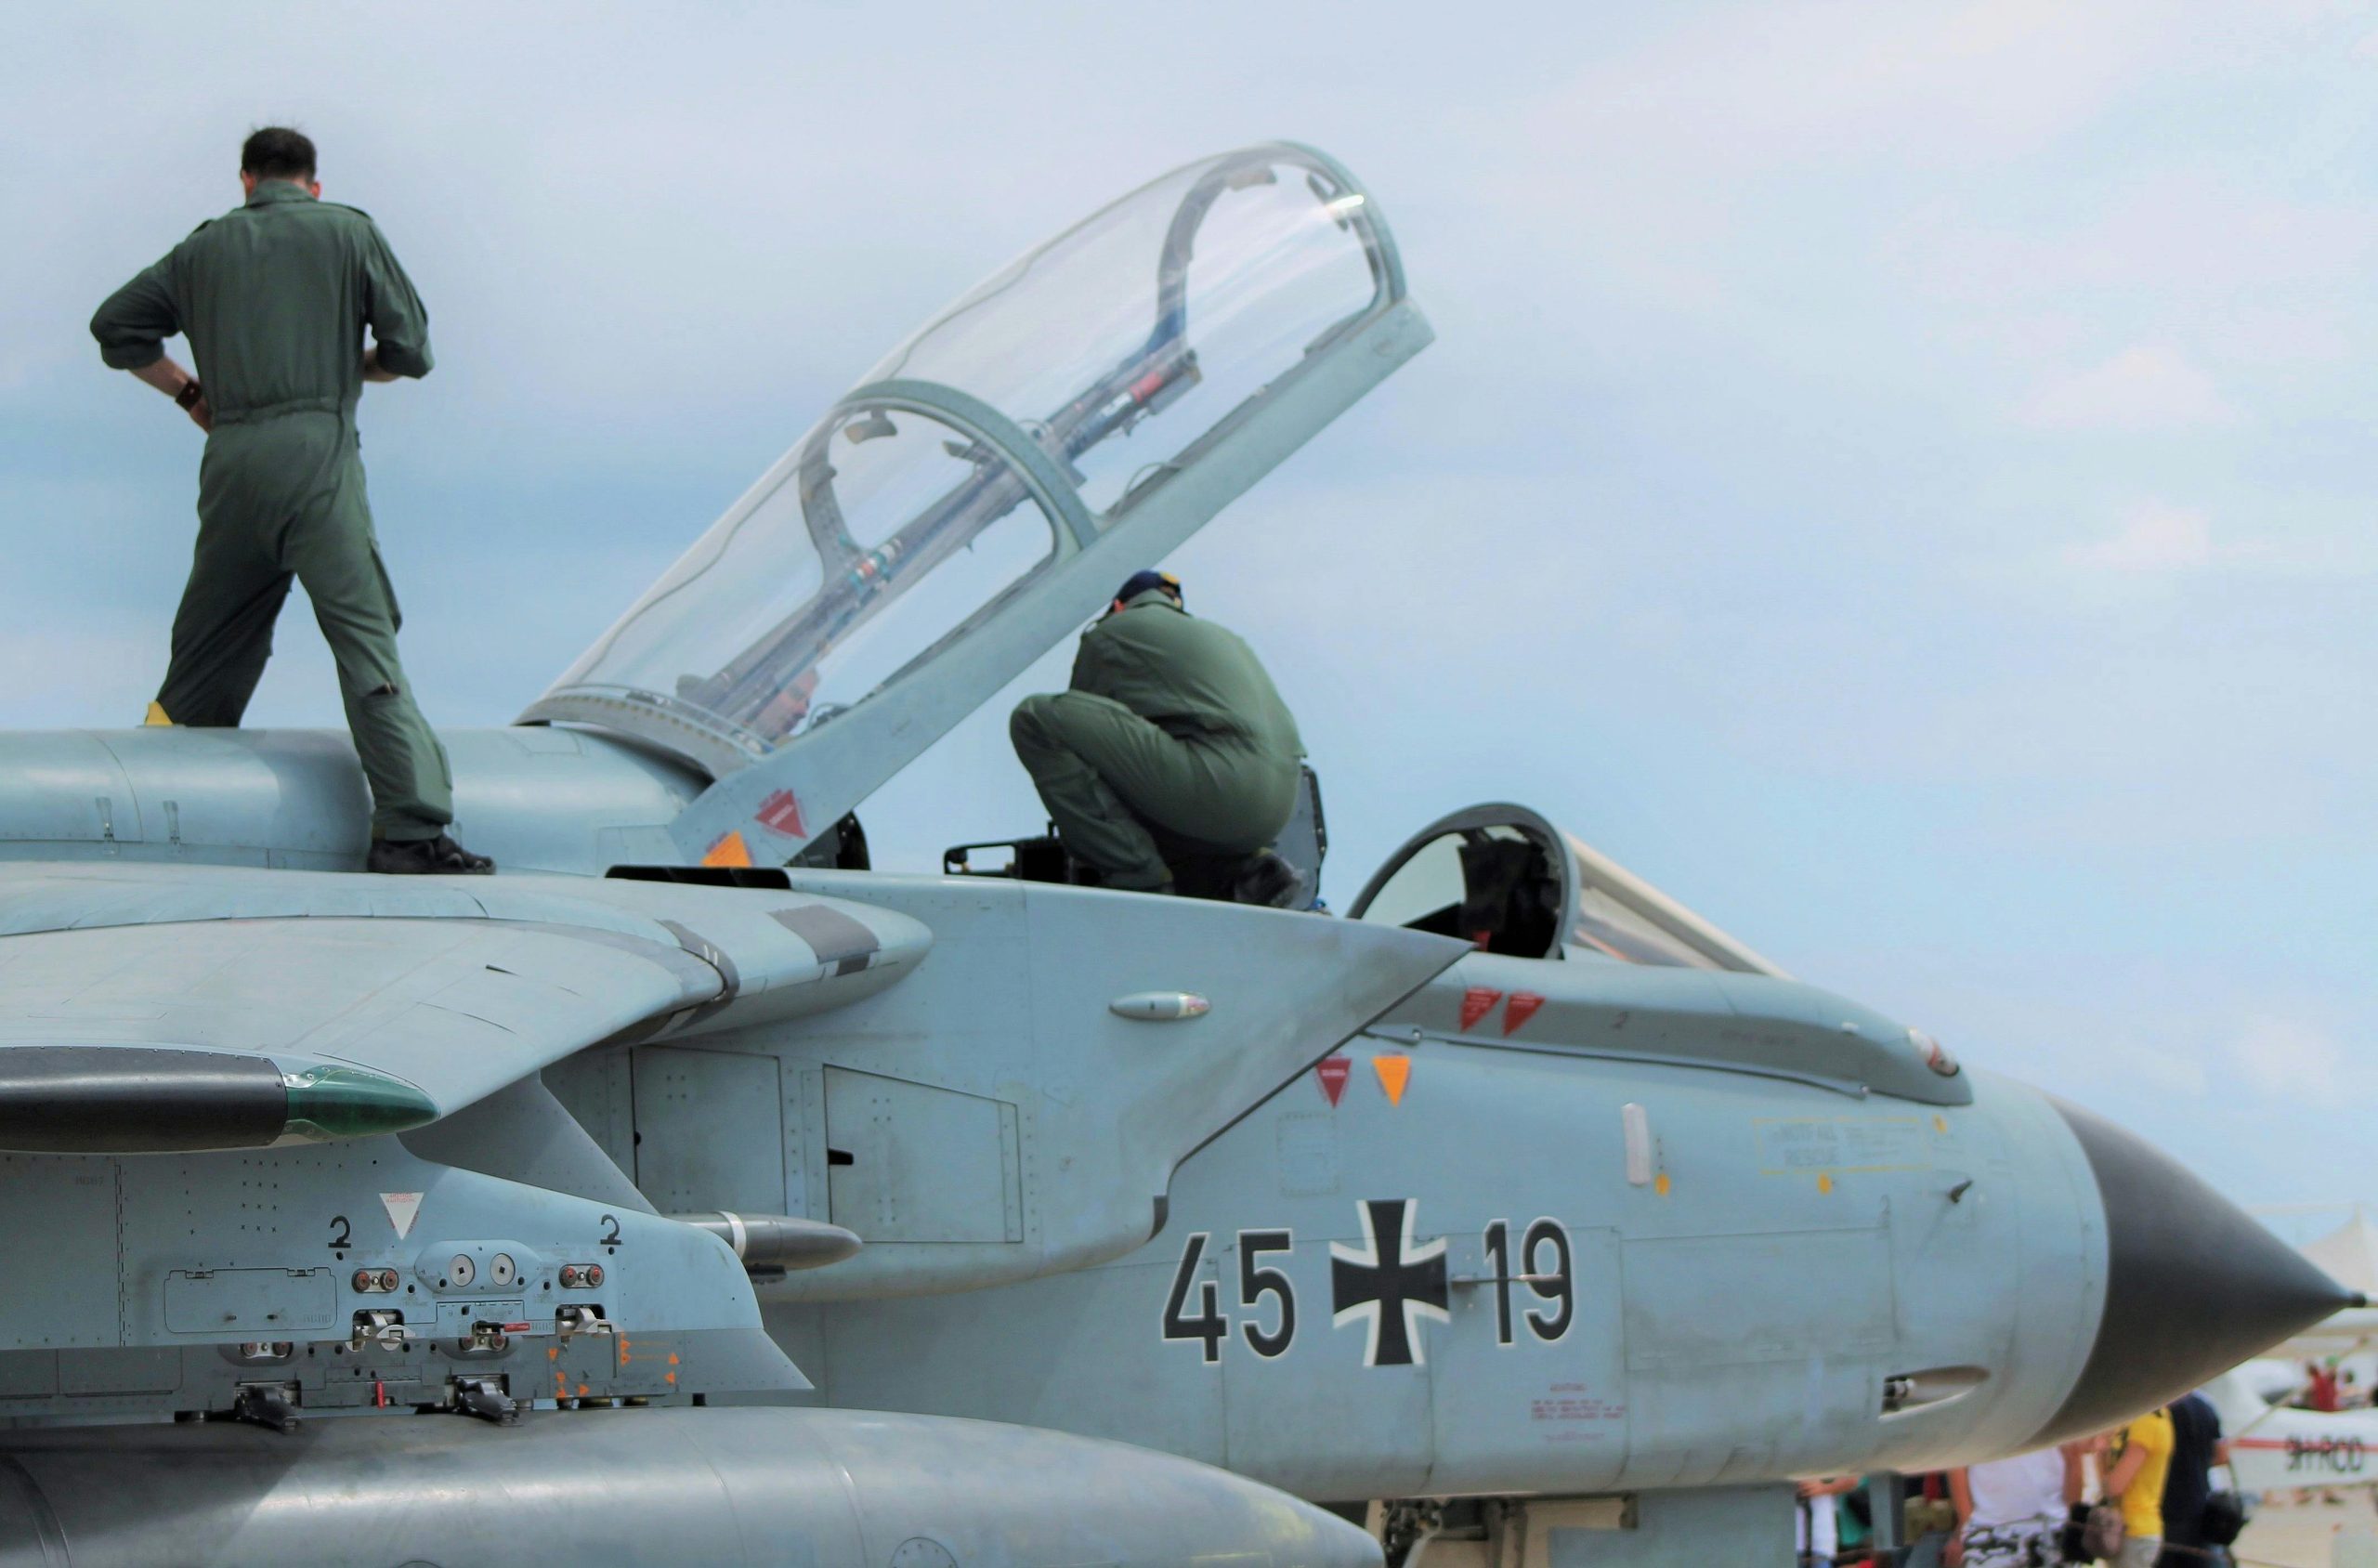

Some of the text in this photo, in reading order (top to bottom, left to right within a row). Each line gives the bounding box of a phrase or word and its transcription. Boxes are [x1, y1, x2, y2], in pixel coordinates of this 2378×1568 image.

[328, 1215, 351, 1248] 2
[600, 1214, 622, 1245] 2
[1162, 1215, 1574, 1364] 45 19
